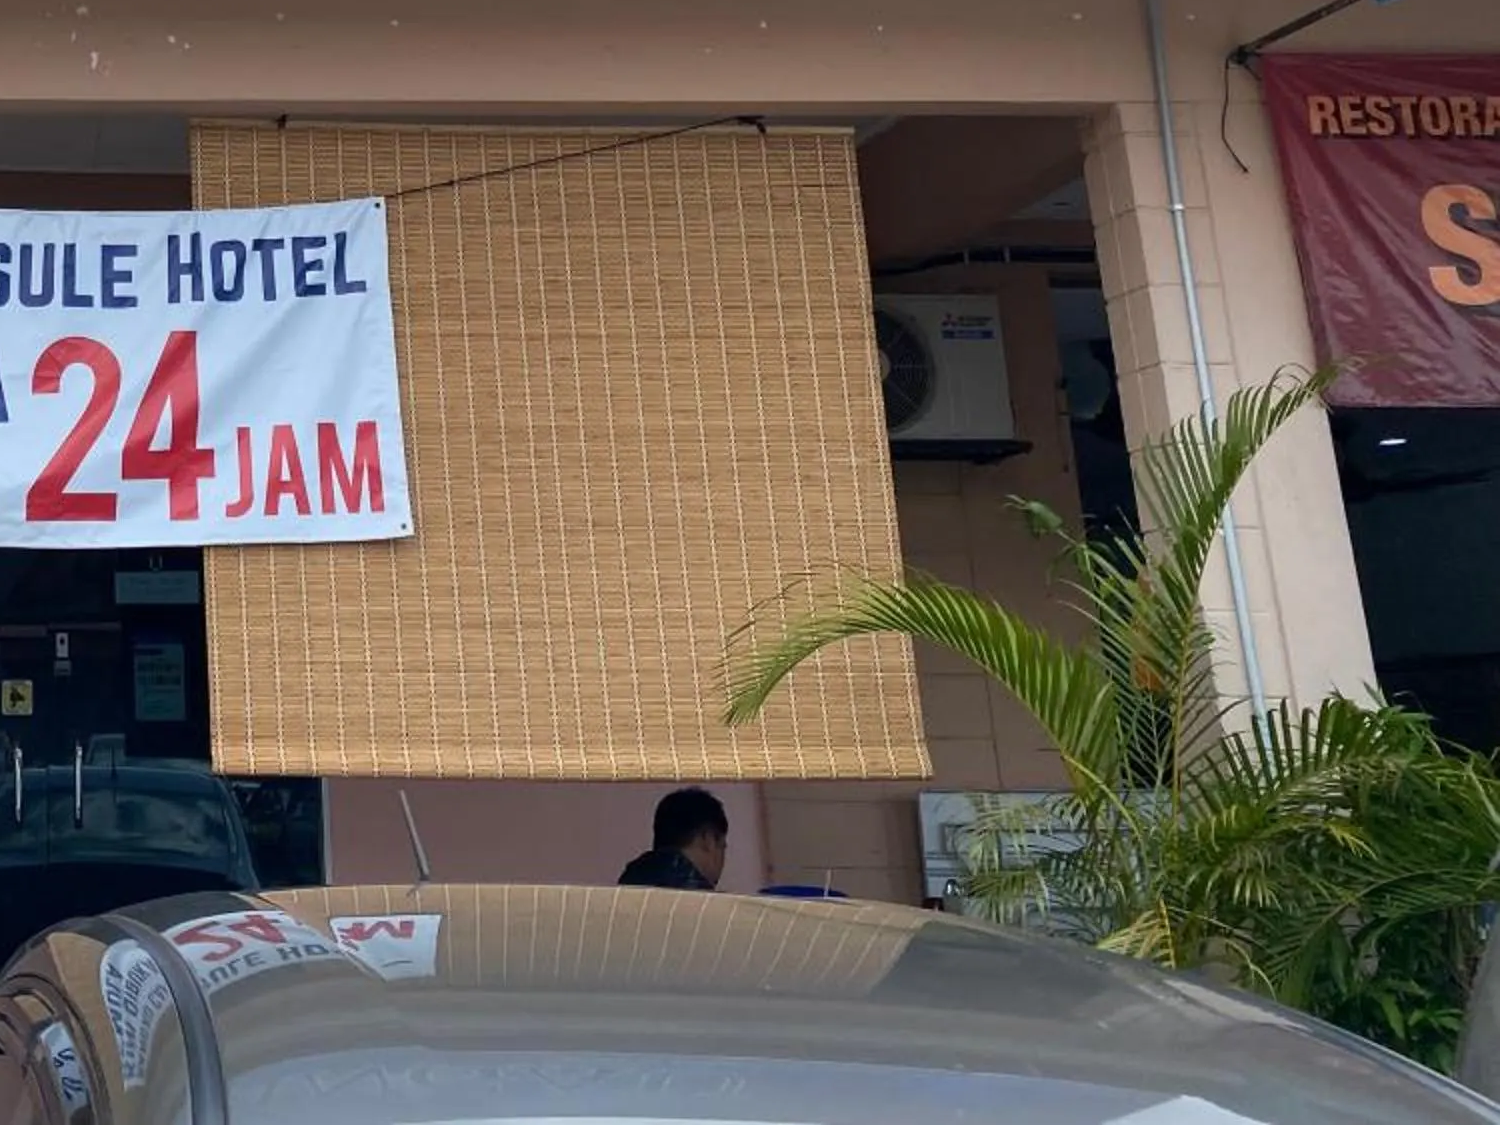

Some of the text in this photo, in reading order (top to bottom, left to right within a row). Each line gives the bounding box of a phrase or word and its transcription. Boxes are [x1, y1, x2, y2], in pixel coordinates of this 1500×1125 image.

[166, 228, 368, 307] HOTEL
[25, 329, 387, 524] 24 JAM
